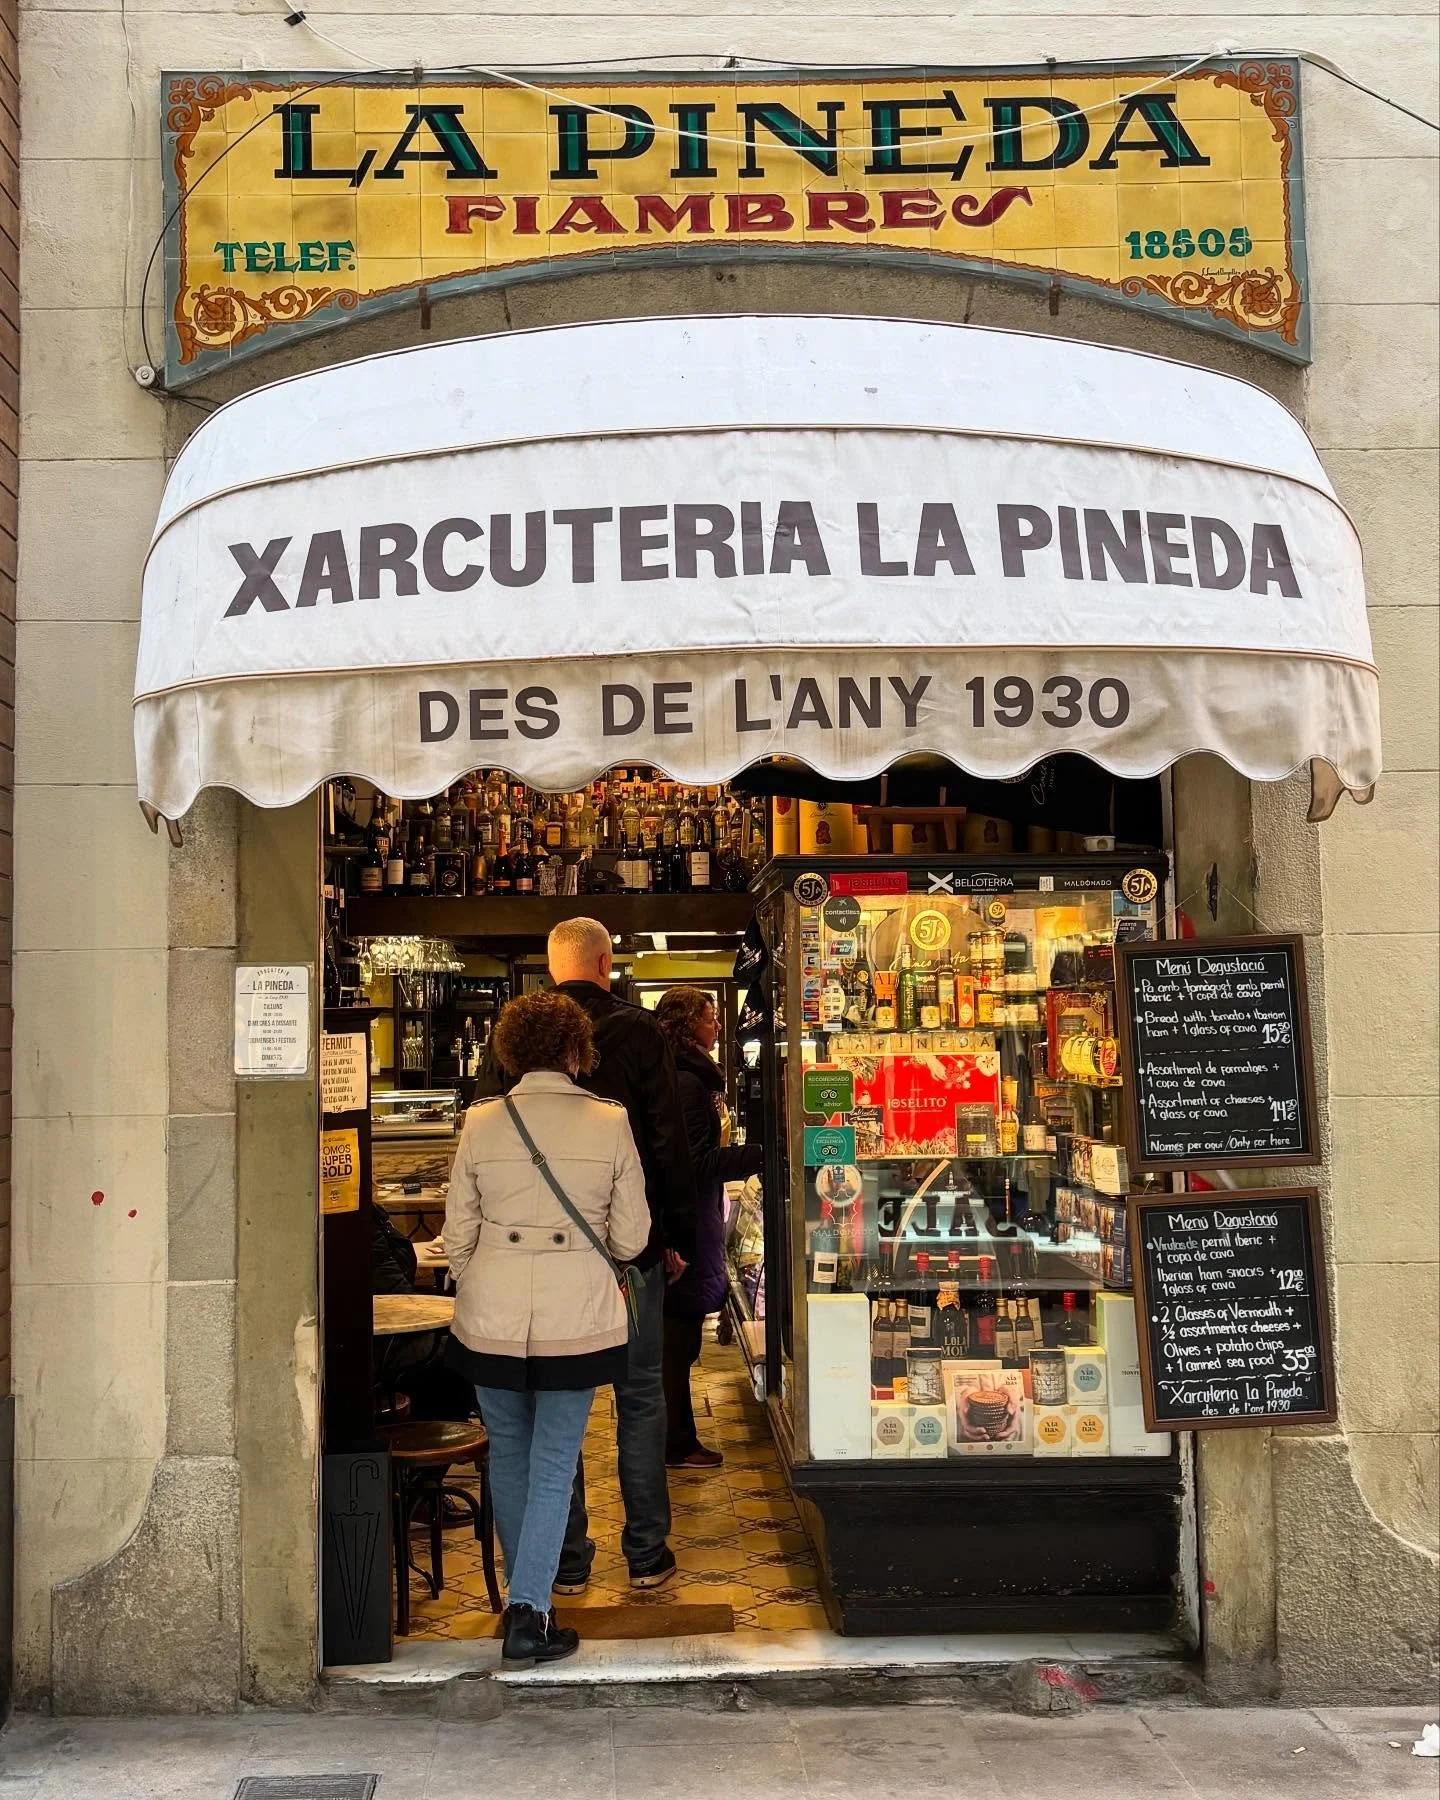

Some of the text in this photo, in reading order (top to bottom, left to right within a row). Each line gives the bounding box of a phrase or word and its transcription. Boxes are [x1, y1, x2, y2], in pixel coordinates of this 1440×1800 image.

[274, 90, 1210, 186] LA PINEDA
[445, 187, 1033, 235] FIAMBRES
[1126, 227, 1254, 260] 18505
[214, 240, 356, 273] TELEF.
[223, 500, 1302, 619] XARCUTERIA LA PINEDA
[419, 675, 1130, 743] DES DE L'ANY 1930
[955, 878, 1014, 888] BELLOTERRA
[1064, 879, 1112, 887] MALDONADO
[1156, 957, 1265, 976] Menú Degustació
[253, 980, 294, 991] LA PINEDA
[1141, 979, 1154, 993] Pa
[1158, 980, 1180, 992] amb
[1237, 978, 1257, 991] amb
[1196, 991, 1218, 1004] copa
[1221, 990, 1234, 999] de
[1237, 991, 1261, 999] cava
[1145, 1011, 1178, 1024] Bread
[1183, 1010, 1207, 1022] with
[1210, 1010, 1244, 1022] tomato
[1147, 1026, 1169, 1038] ham
[1220, 1024, 1231, 1036] of
[1233, 1024, 1257, 1034] cava
[1147, 1062, 1202, 1076] Assortiment
[1206, 1062, 1217, 1074] de
[1221, 1061, 1268, 1078] formatges
[1156, 1080, 1179, 1091] copa
[1183, 1076, 1195, 1088] de
[1201, 1078, 1226, 1088] cava
[887, 1096, 947, 1109] JOSELITO
[1148, 1091, 1207, 1109] Assortment
[1210, 1096, 1221, 1109] of
[1225, 1093, 1265, 1105] cheeses
[1160, 1108, 1186, 1120] glass
[1189, 1108, 1200, 1120] of
[1204, 1108, 1228, 1118] cava
[323, 1144, 351, 1155] OMOS
[1188, 1142, 1203, 1155] per
[1254, 1138, 1266, 1148] for
[1270, 1133, 1290, 1145] here
[1168, 1210, 1278, 1230] Menú Degustació
[1202, 1235, 1231, 1251] pernil
[1167, 1252, 1191, 1265] copa
[1194, 1250, 1208, 1261] de
[1210, 1249, 1234, 1259] cava
[1157, 1268, 1193, 1282] Iberian
[1198, 1266, 1222, 1280] ham
[1197, 1283, 1208, 1295] of
[1212, 1280, 1235, 1291] cava
[1161, 1306, 1169, 1323] 2
[1175, 1305, 1215, 1322] Glasses
[1217, 1309, 1228, 1321] of
[1228, 1300, 1282, 1318] Vermouth
[1180, 1321, 1236, 1338] assortment
[1237, 1321, 1248, 1333] of
[1250, 1321, 1290, 1333] cheeses
[1164, 1341, 1200, 1358] Olives
[1216, 1339, 1253, 1356] potato
[1256, 1339, 1284, 1350] chips
[1227, 1358, 1245, 1369] sea
[1249, 1354, 1274, 1369] food
[1246, 1383, 1259, 1400] La
[1202, 1405, 1218, 1416] des
[1229, 1402, 1239, 1414] de
[1267, 1400, 1290, 1412] 1930
